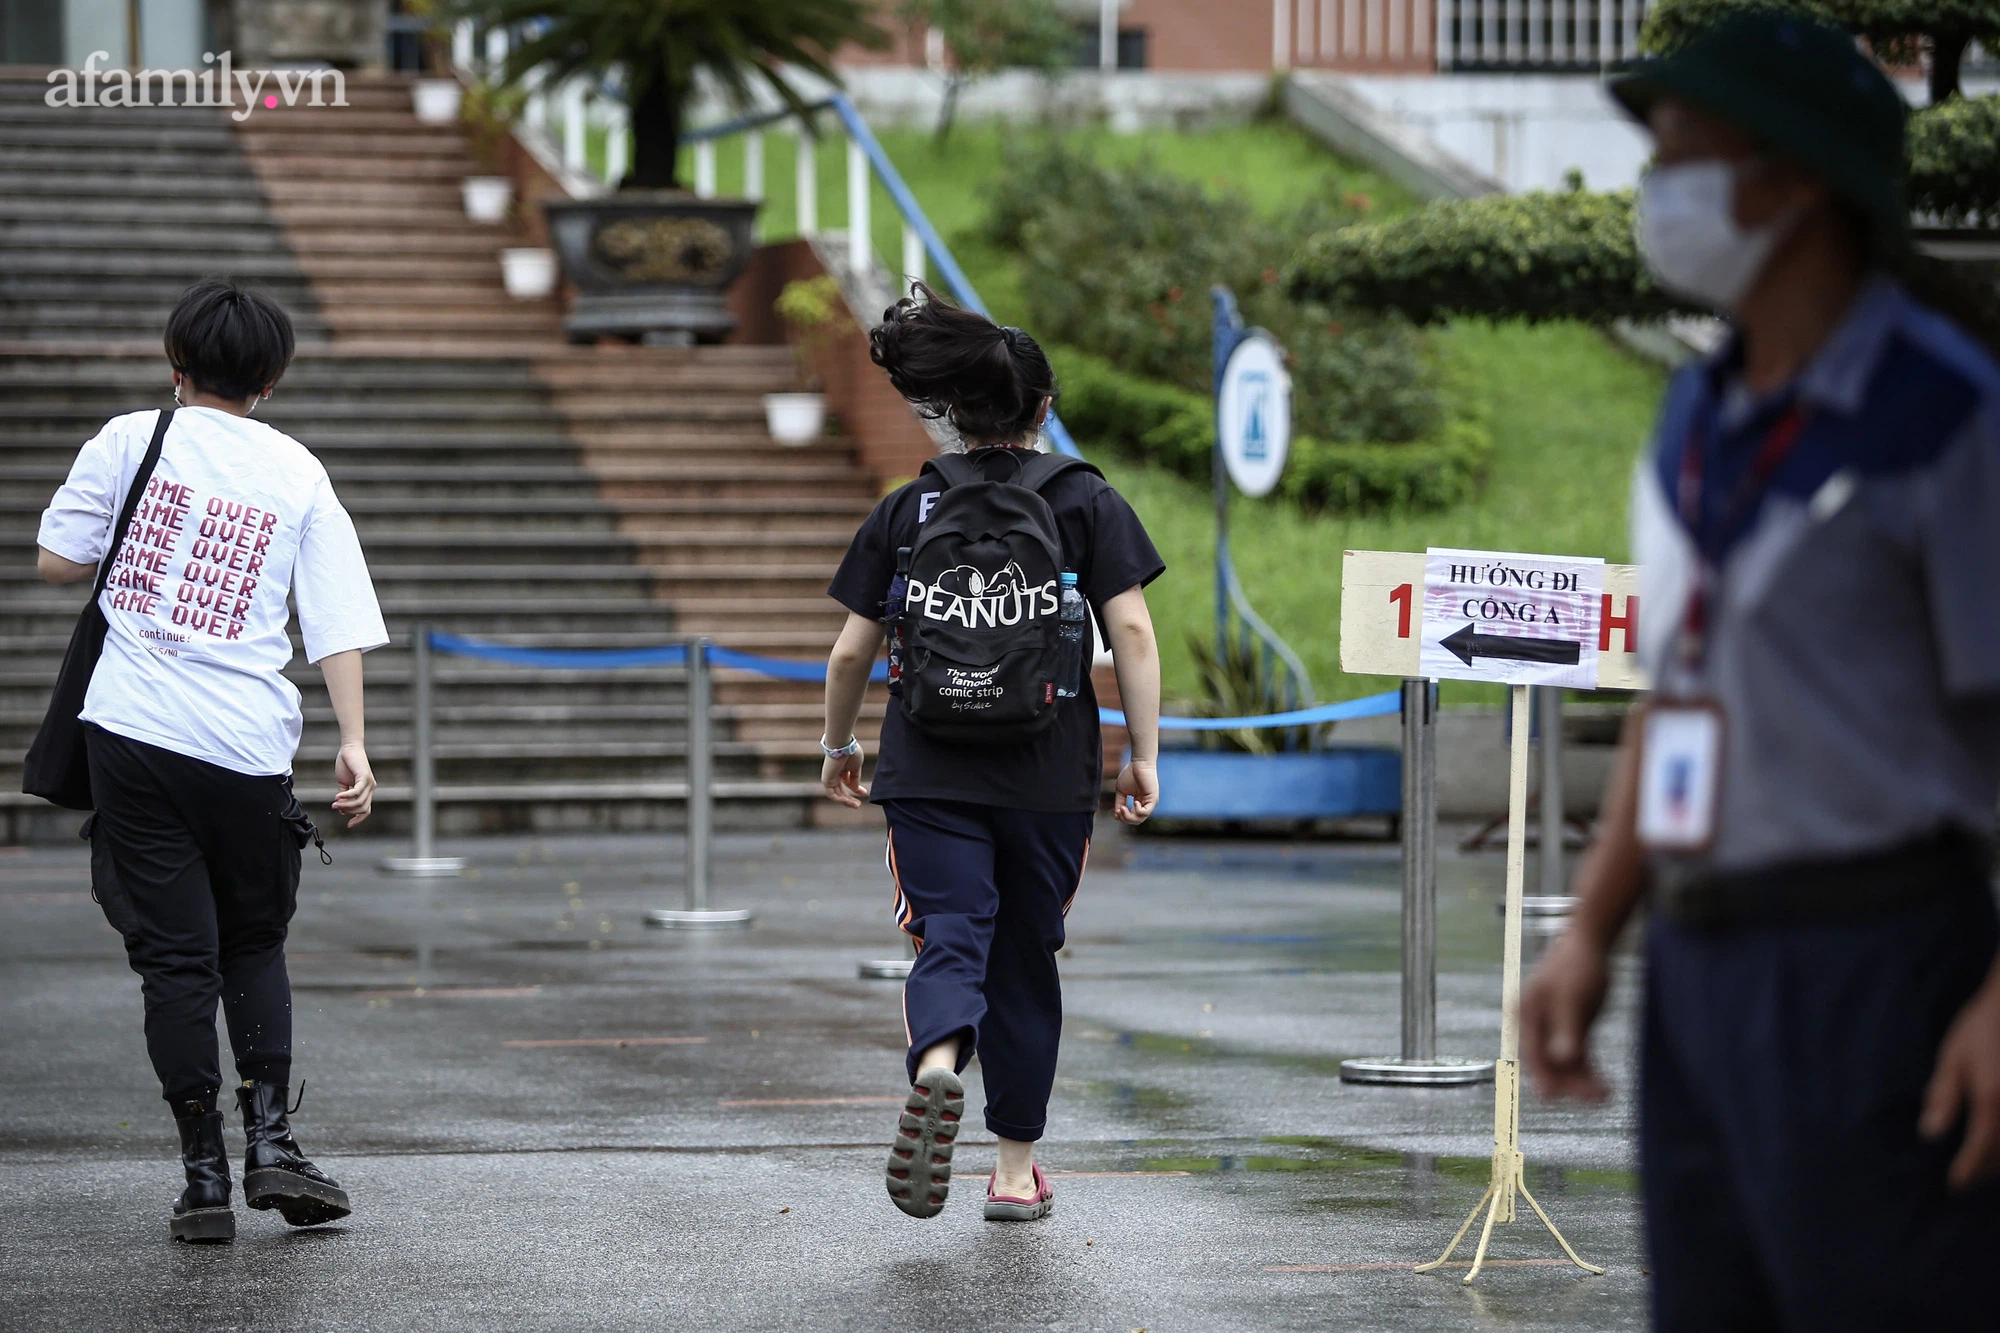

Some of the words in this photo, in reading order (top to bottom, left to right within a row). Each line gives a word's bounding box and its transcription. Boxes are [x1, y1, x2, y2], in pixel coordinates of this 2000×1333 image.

[148, 476, 195, 508] AME
[206, 497, 277, 534] OVER
[199, 517, 271, 556] OVER
[191, 539, 263, 577] OVER
[109, 564, 165, 596] GAME
[176, 582, 251, 621] OVER
[183, 561, 257, 599] OVER
[1449, 562, 1544, 590] HƯỚNG
[1551, 572, 1579, 592] ĐI
[905, 578, 1059, 629] PEANUTS
[1543, 606, 1560, 625] A
[139, 628, 192, 643] continue?
[171, 604, 244, 641] OVER
[946, 668, 967, 678] The
[970, 664, 1000, 679] world
[951, 676, 993, 688] famous
[939, 686, 973, 698] comic
[976, 685, 1003, 698] strip
